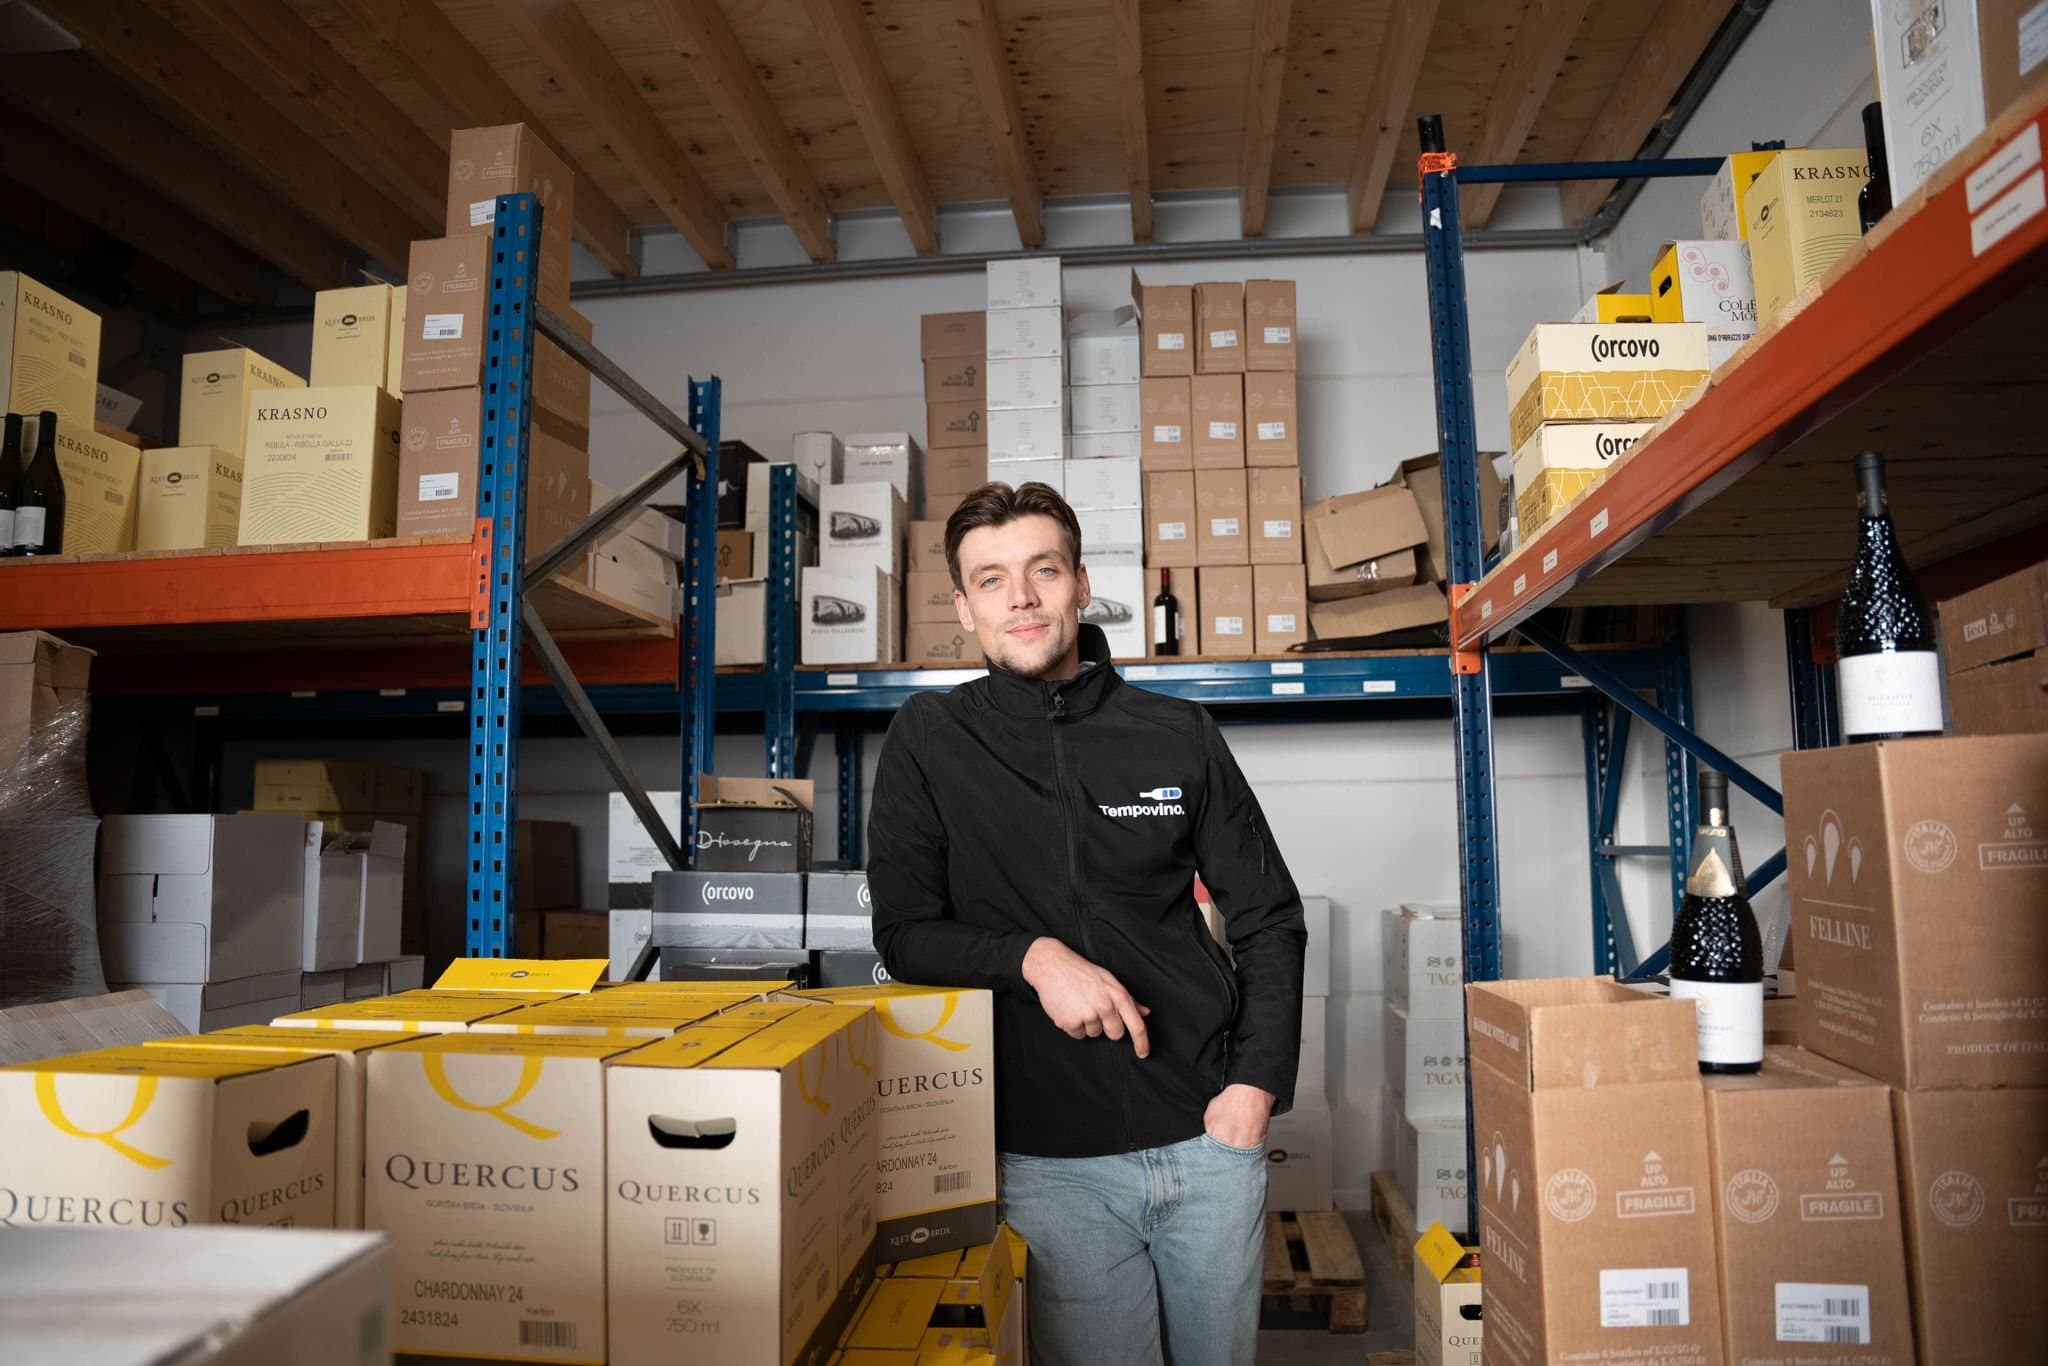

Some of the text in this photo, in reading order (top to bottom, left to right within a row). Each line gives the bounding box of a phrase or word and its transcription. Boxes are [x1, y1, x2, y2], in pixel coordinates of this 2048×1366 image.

[24, 291, 73, 326] KRASNO
[250, 364, 286, 389] KRASNO
[257, 407, 328, 421] KRASNO
[58, 434, 109, 464] KRASNO
[215, 463, 243, 484] KRAS
[2008, 816, 2026, 828] UP
[2003, 828, 2033, 840] ALTO
[696, 830, 792, 862] Dissegna
[1809, 914, 1873, 952] FELLINE
[1473, 1016, 1491, 1038] HANDLE
[1947, 1041, 2048, 1056] PRODUCT OF ITAL
[877, 1067, 983, 1098] UERCUS
[386, 1154, 580, 1193] QUERCUS
[788, 1129, 837, 1198] QUERCUS
[876, 1152, 938, 1175] ARDONNAY 24
[1644, 1163, 1663, 1175] UP
[1829, 1167, 1849, 1178] UP
[875, 1181, 894, 1194] 824
[1640, 1175, 1669, 1188] ALTO
[1825, 1179, 1855, 1191] ALTO
[221, 1173, 325, 1225] QUERCUS
[618, 1179, 761, 1206] QUERCUS
[1625, 1194, 1687, 1211] FRAGILE
[0, 1187, 190, 1230] QUERCUS
[1809, 1199, 1874, 1215] FRAGILE
[1486, 1224, 1527, 1283] FELLINE
[414, 1279, 524, 1304] CHARDONNAY 24
[401, 1310, 460, 1328] 2431824
[665, 1317, 699, 1334] 750
[1448, 1335, 1481, 1348] QUE
